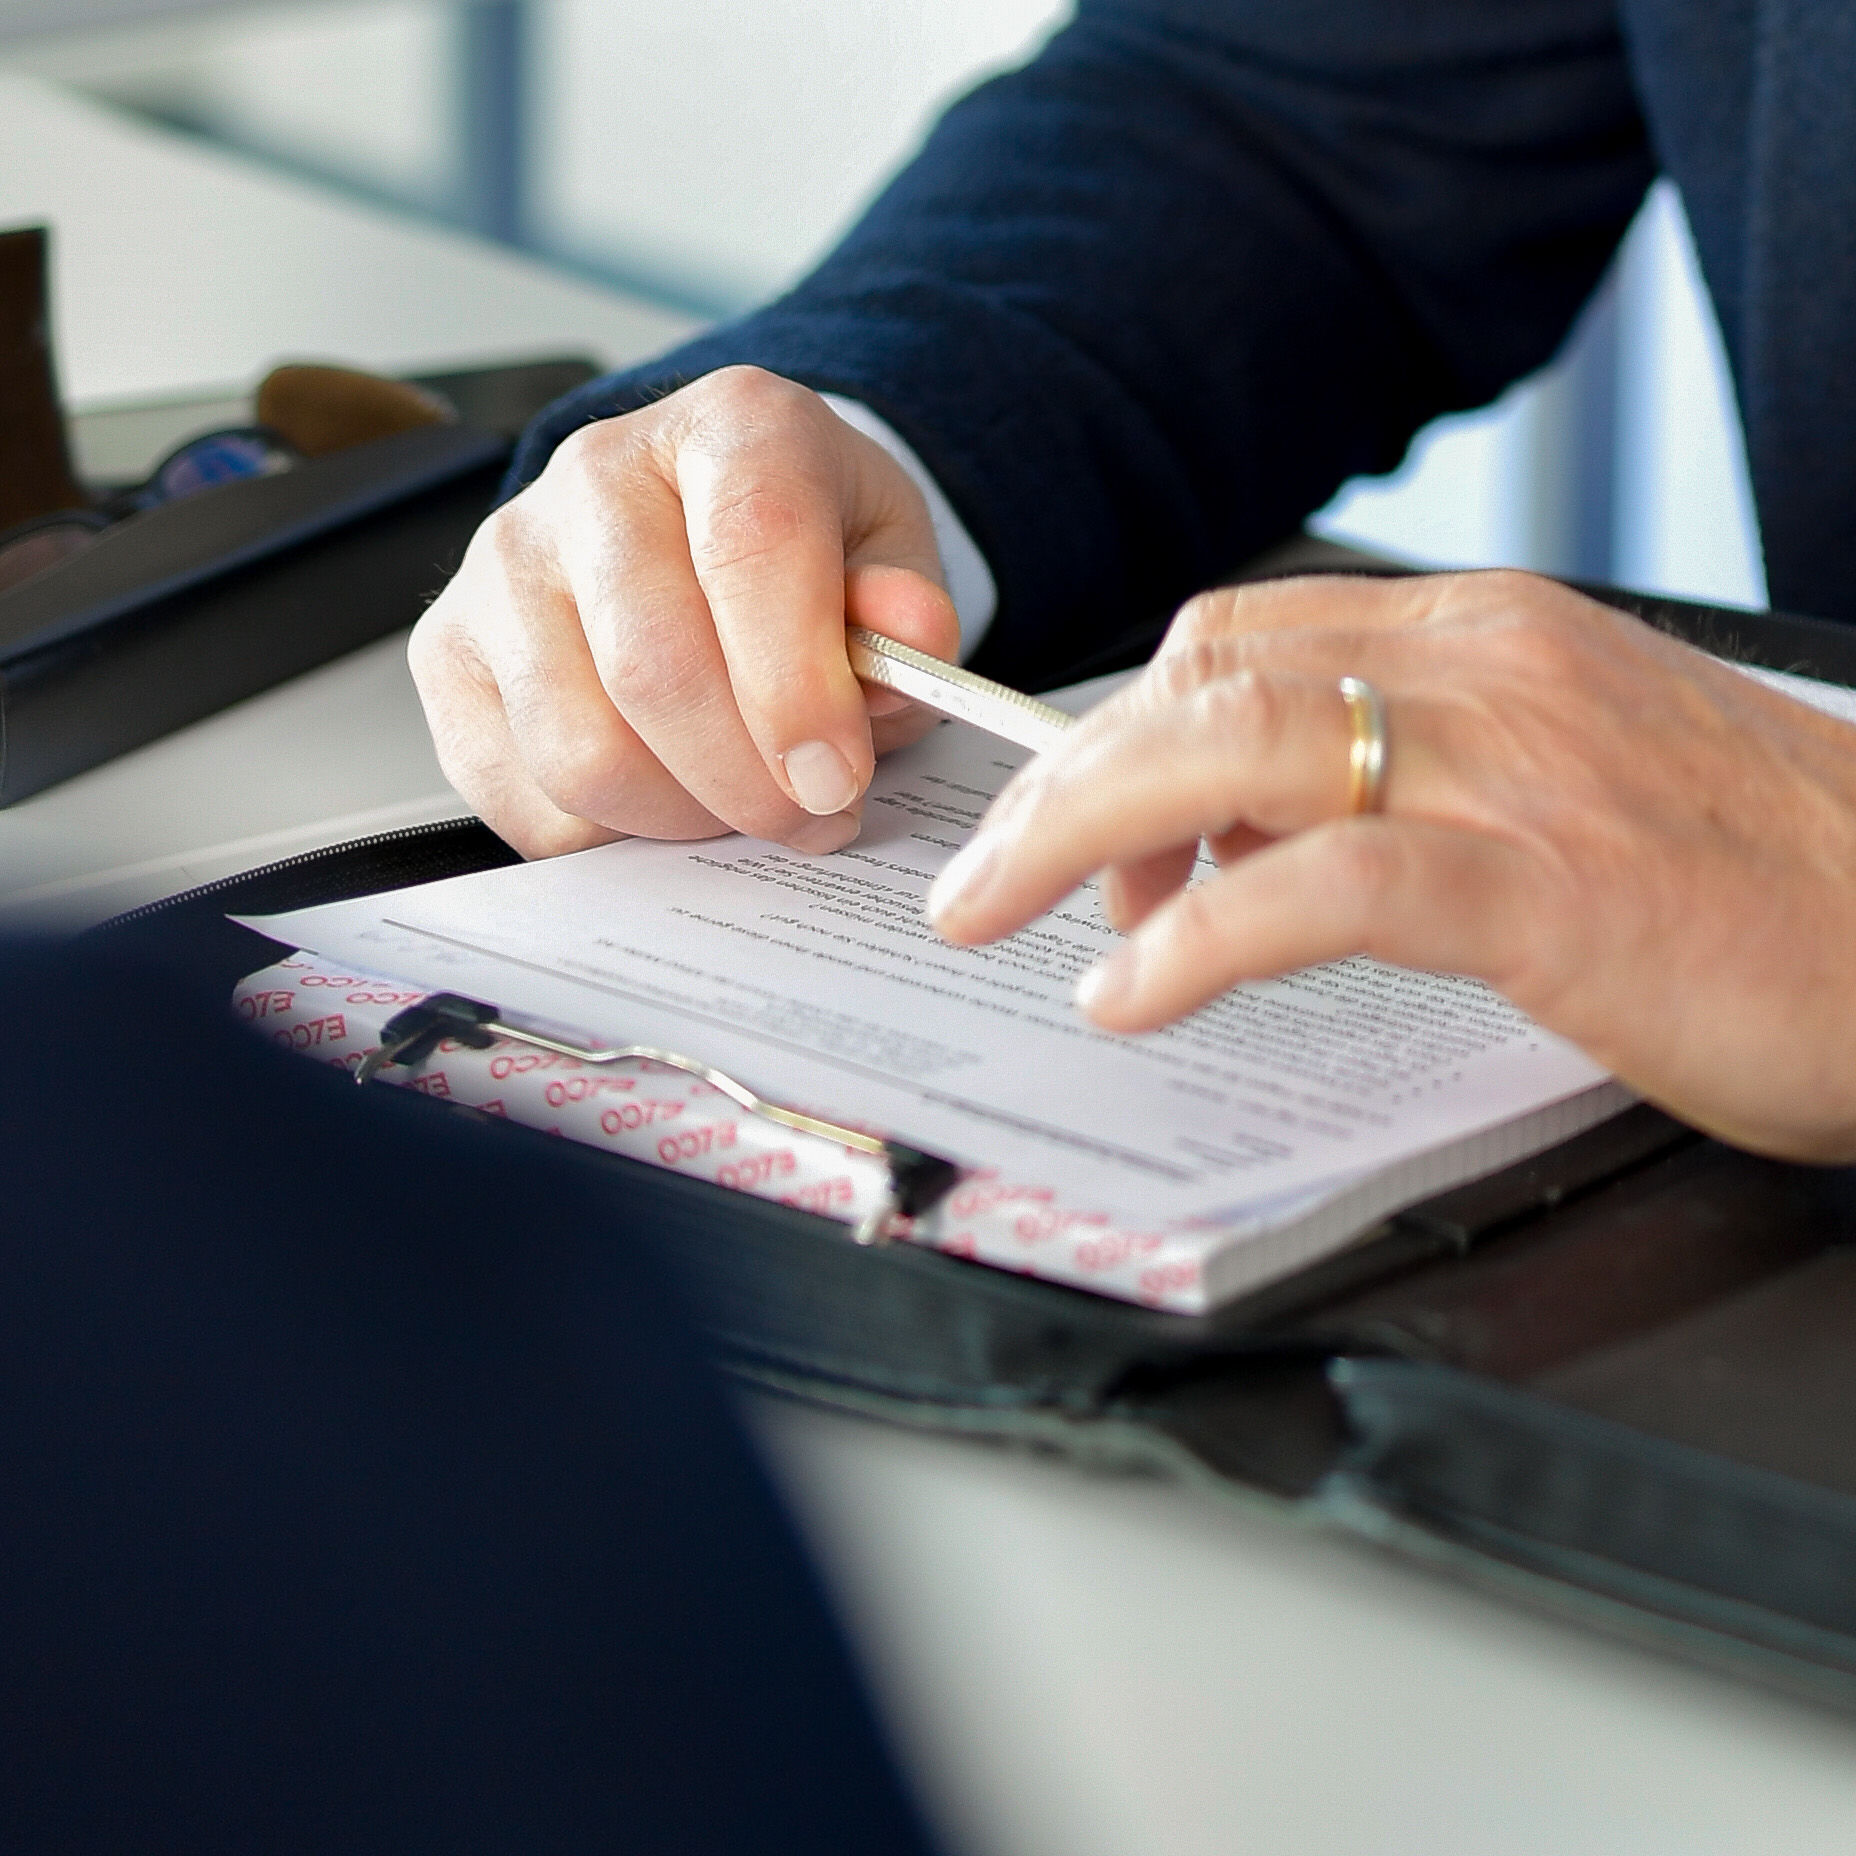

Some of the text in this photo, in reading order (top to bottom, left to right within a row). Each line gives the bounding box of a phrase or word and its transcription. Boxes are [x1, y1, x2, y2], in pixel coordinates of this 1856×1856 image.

[686, 852, 752, 877] mögliche
[735, 856, 766, 870] Wie
[760, 851, 790, 864] der
[750, 872, 776, 884] das
[762, 864, 797, 879] Sie?
[795, 872, 861, 896] erwarten
[858, 891, 925, 915] Besucher
[891, 888, 920, 901] zur
[601, 1100, 687, 1135] ELCO
[657, 1120, 737, 1164] ELCO
